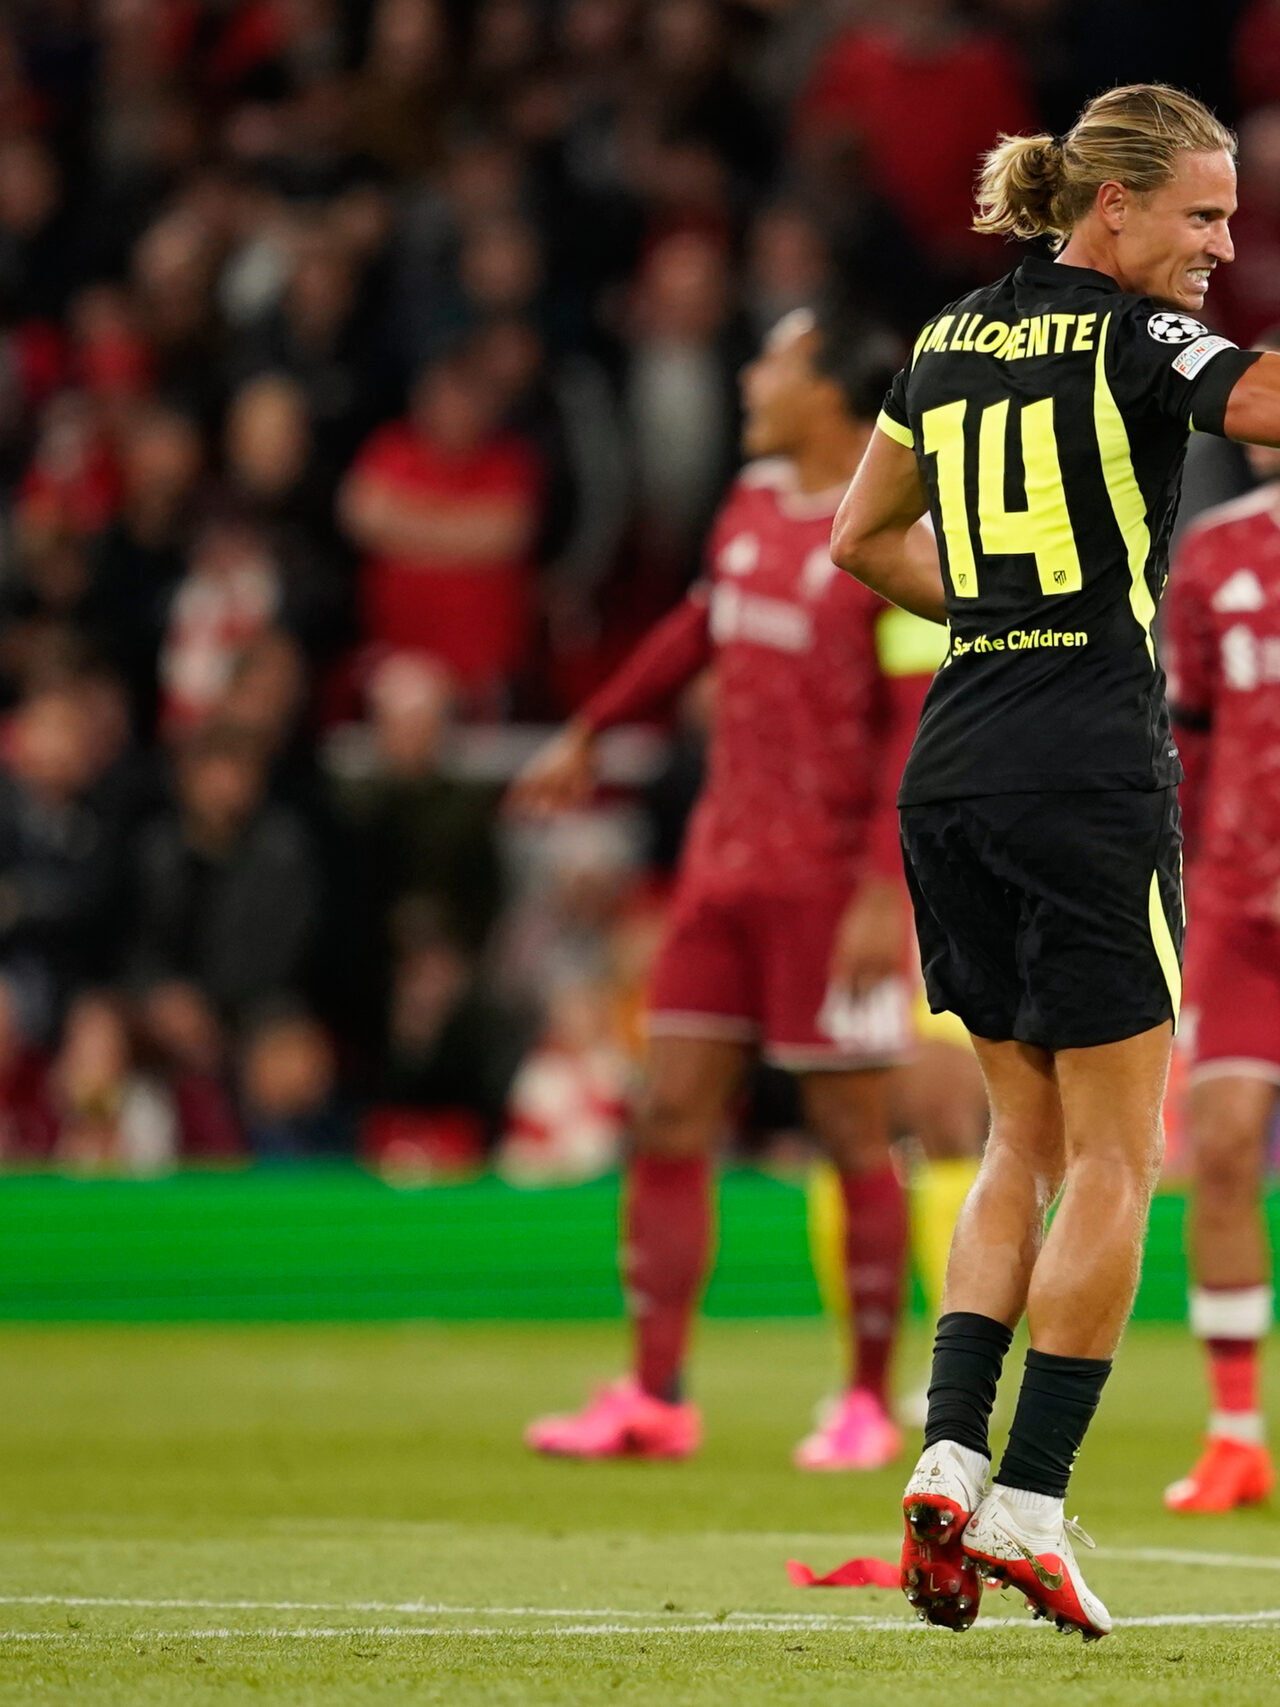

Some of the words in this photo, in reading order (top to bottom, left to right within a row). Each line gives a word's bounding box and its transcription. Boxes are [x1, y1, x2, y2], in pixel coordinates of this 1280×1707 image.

[922, 397, 1083, 598] 14
[974, 634, 1005, 653] the
[1007, 629, 1088, 651] Children
